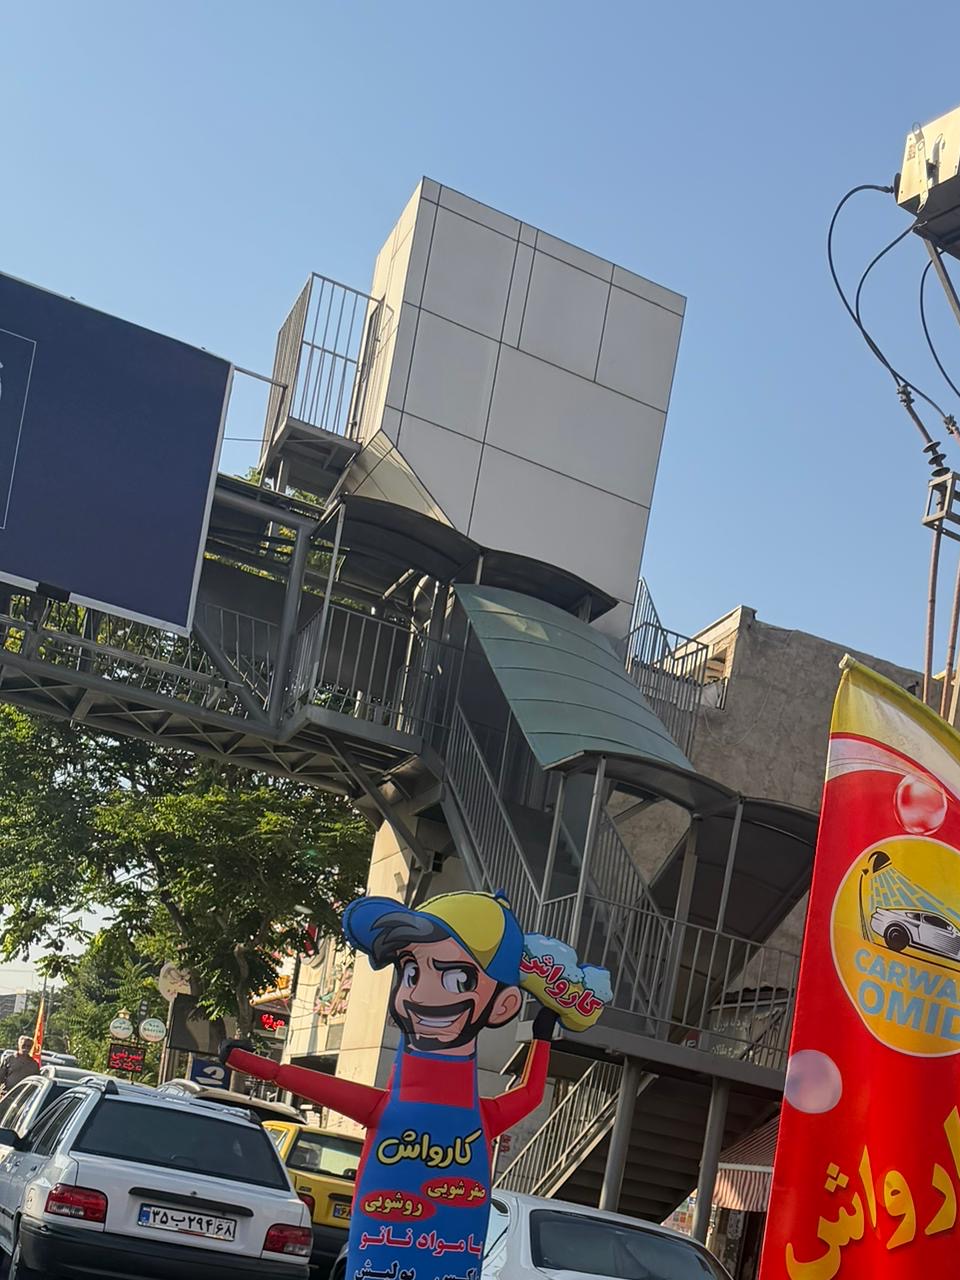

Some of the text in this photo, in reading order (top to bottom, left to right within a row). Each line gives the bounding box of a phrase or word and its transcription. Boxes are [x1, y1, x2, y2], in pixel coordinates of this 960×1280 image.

[377, 1129, 482, 1168] کارواش
[359, 1226, 413, 1250] نانو
[416, 1230, 466, 1256] مواد
